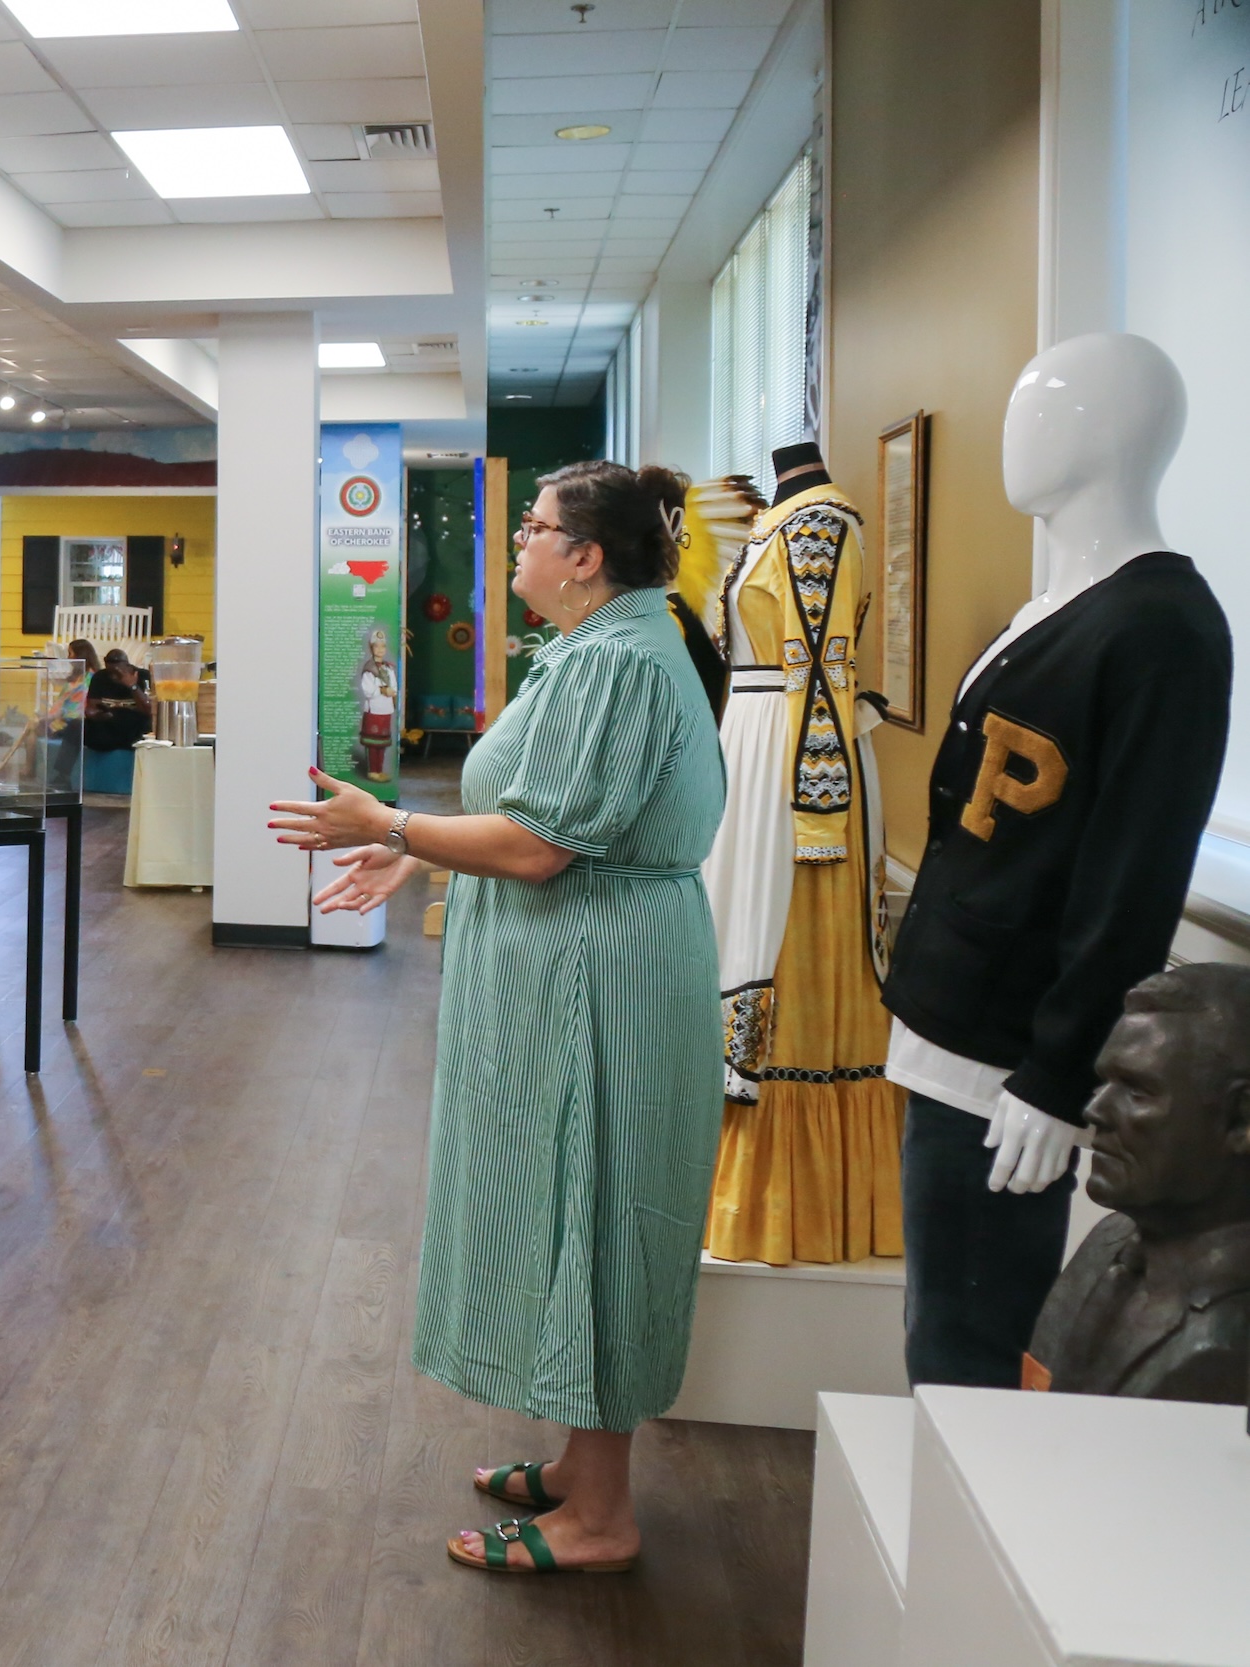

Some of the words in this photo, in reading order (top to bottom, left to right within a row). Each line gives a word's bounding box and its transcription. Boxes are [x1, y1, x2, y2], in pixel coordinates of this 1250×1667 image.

[328, 528, 366, 536] EASTERN
[368, 528, 392, 536] BAND
[330, 538, 342, 546] OF
[344, 538, 390, 546] CHEROKEE
[961, 712, 1069, 842] P
